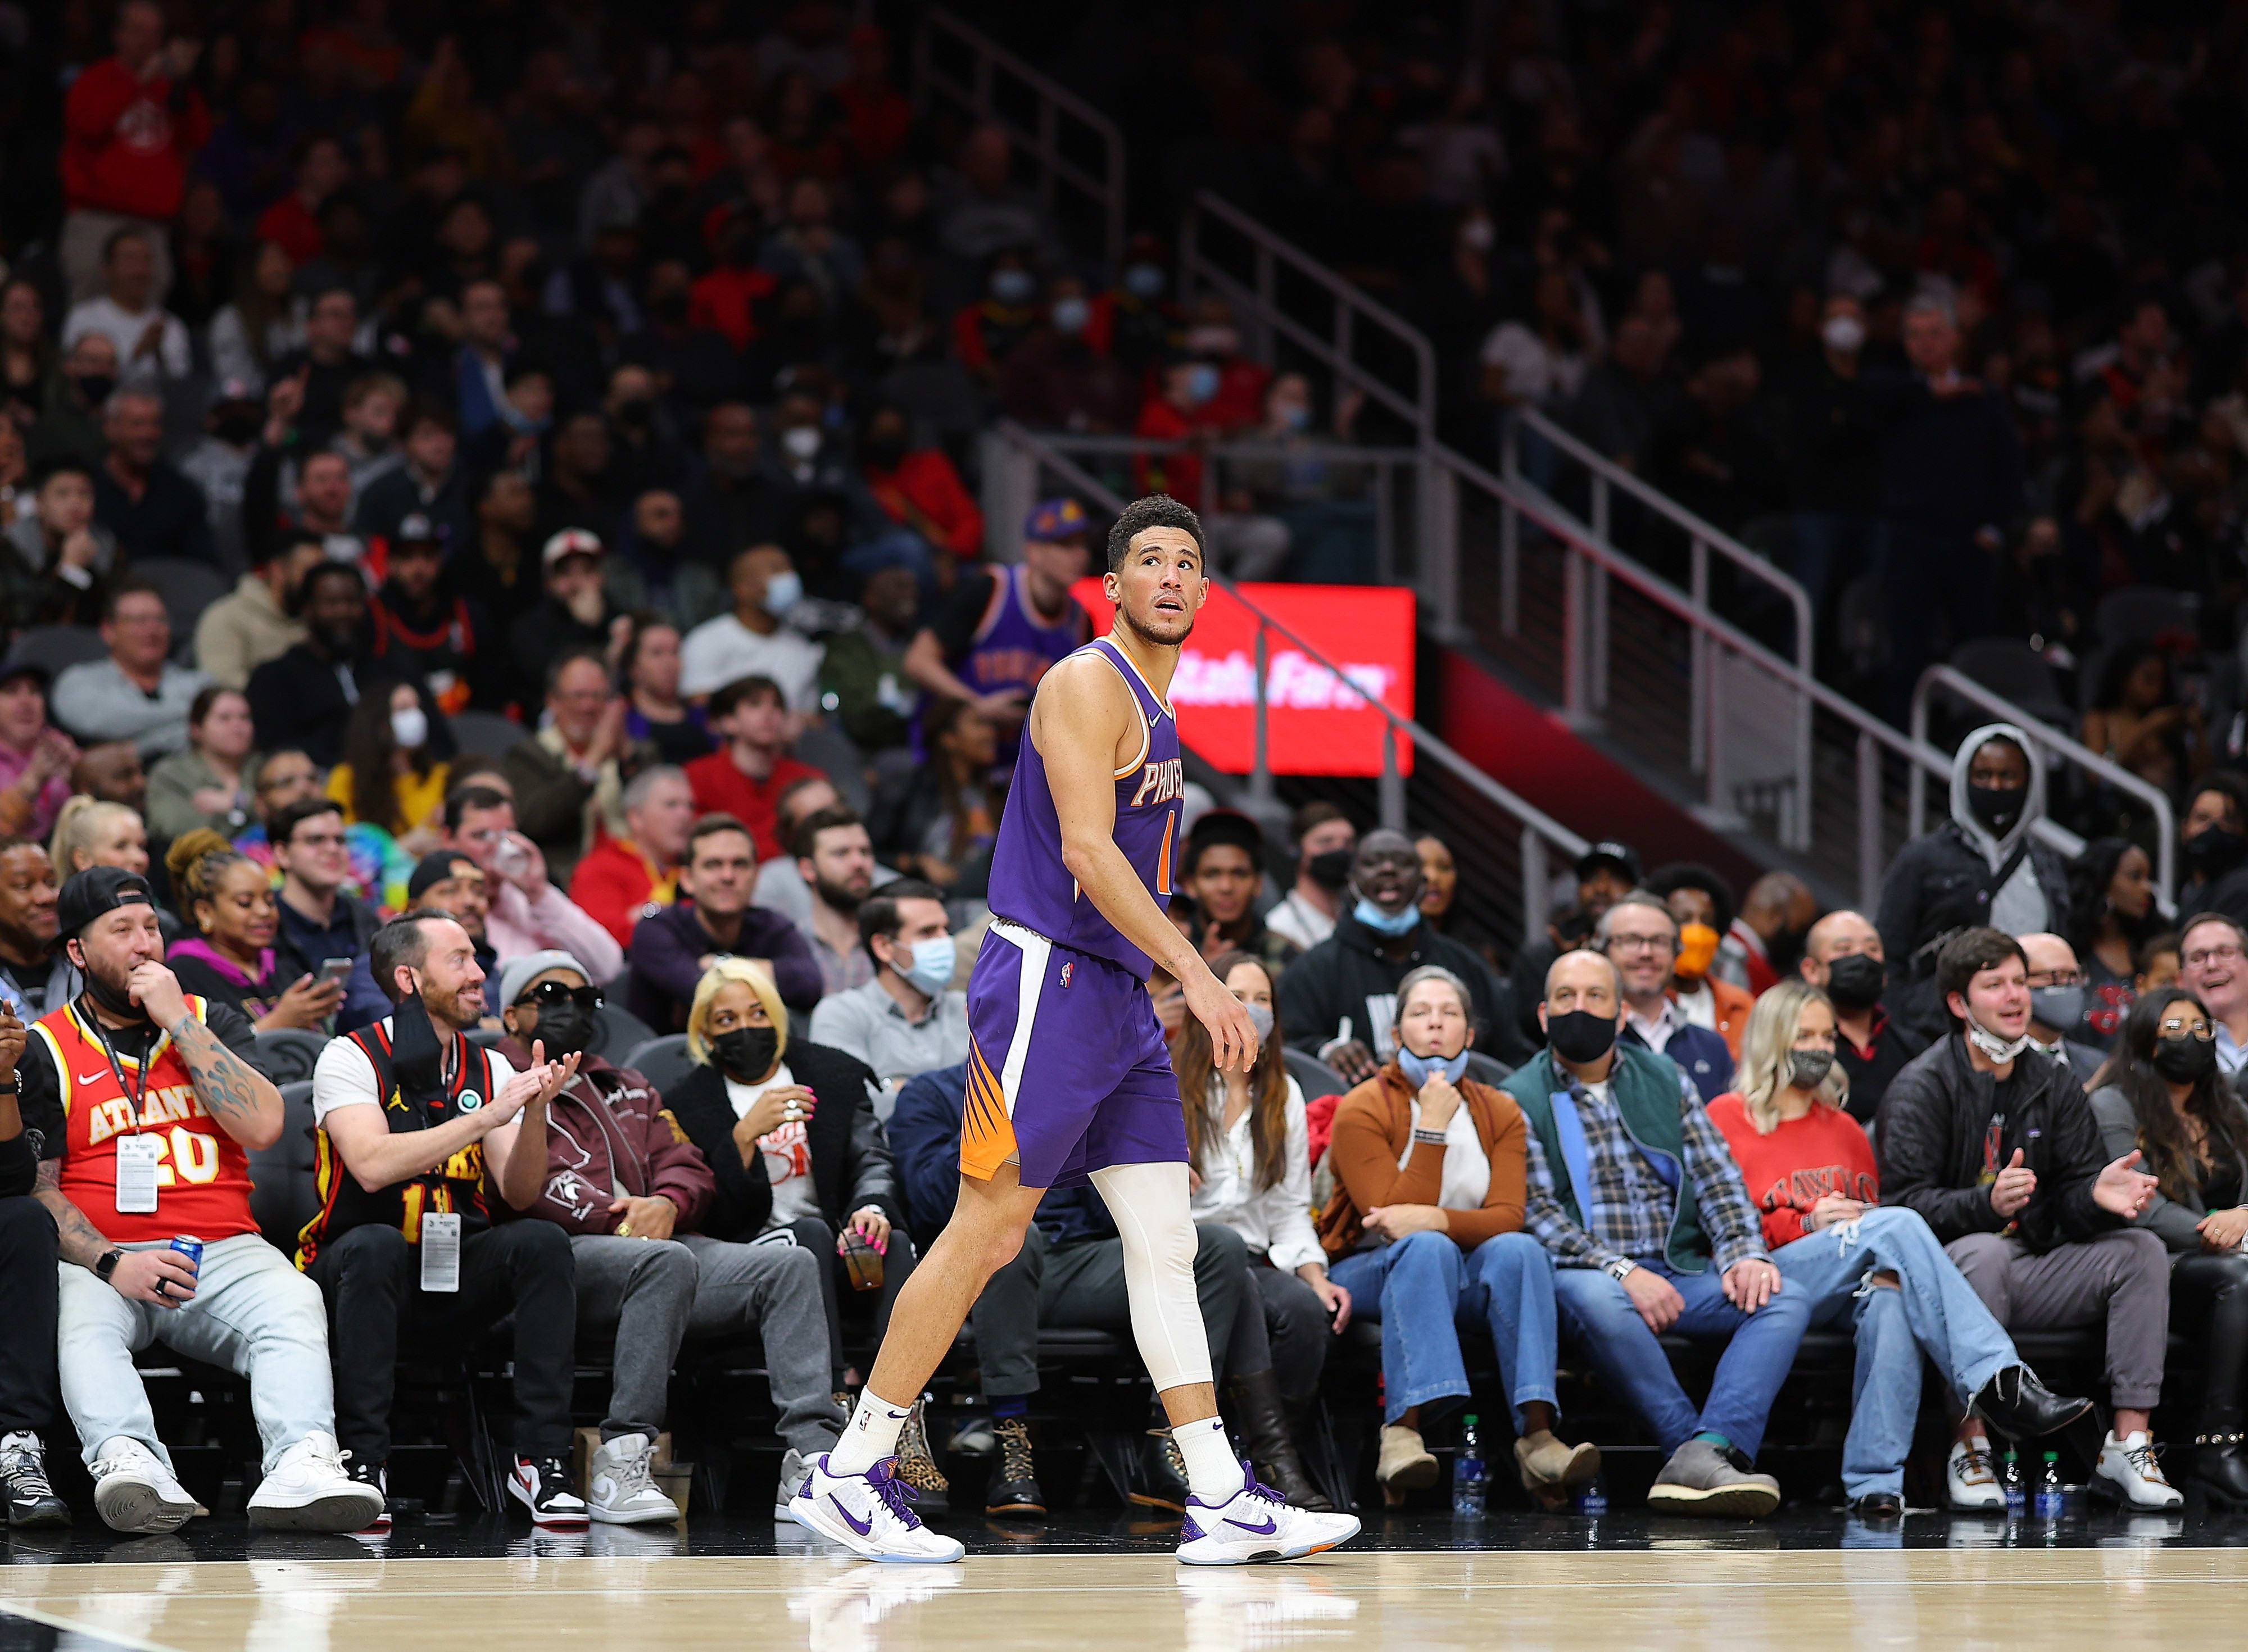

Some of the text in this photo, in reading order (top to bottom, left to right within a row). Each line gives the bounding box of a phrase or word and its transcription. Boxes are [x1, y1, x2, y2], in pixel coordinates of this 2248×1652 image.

[1130, 758, 1184, 806] PHOE
[1157, 810, 1173, 896] 1
[89, 1084, 212, 1147] ATLANT
[139, 1124, 220, 1187] 20
